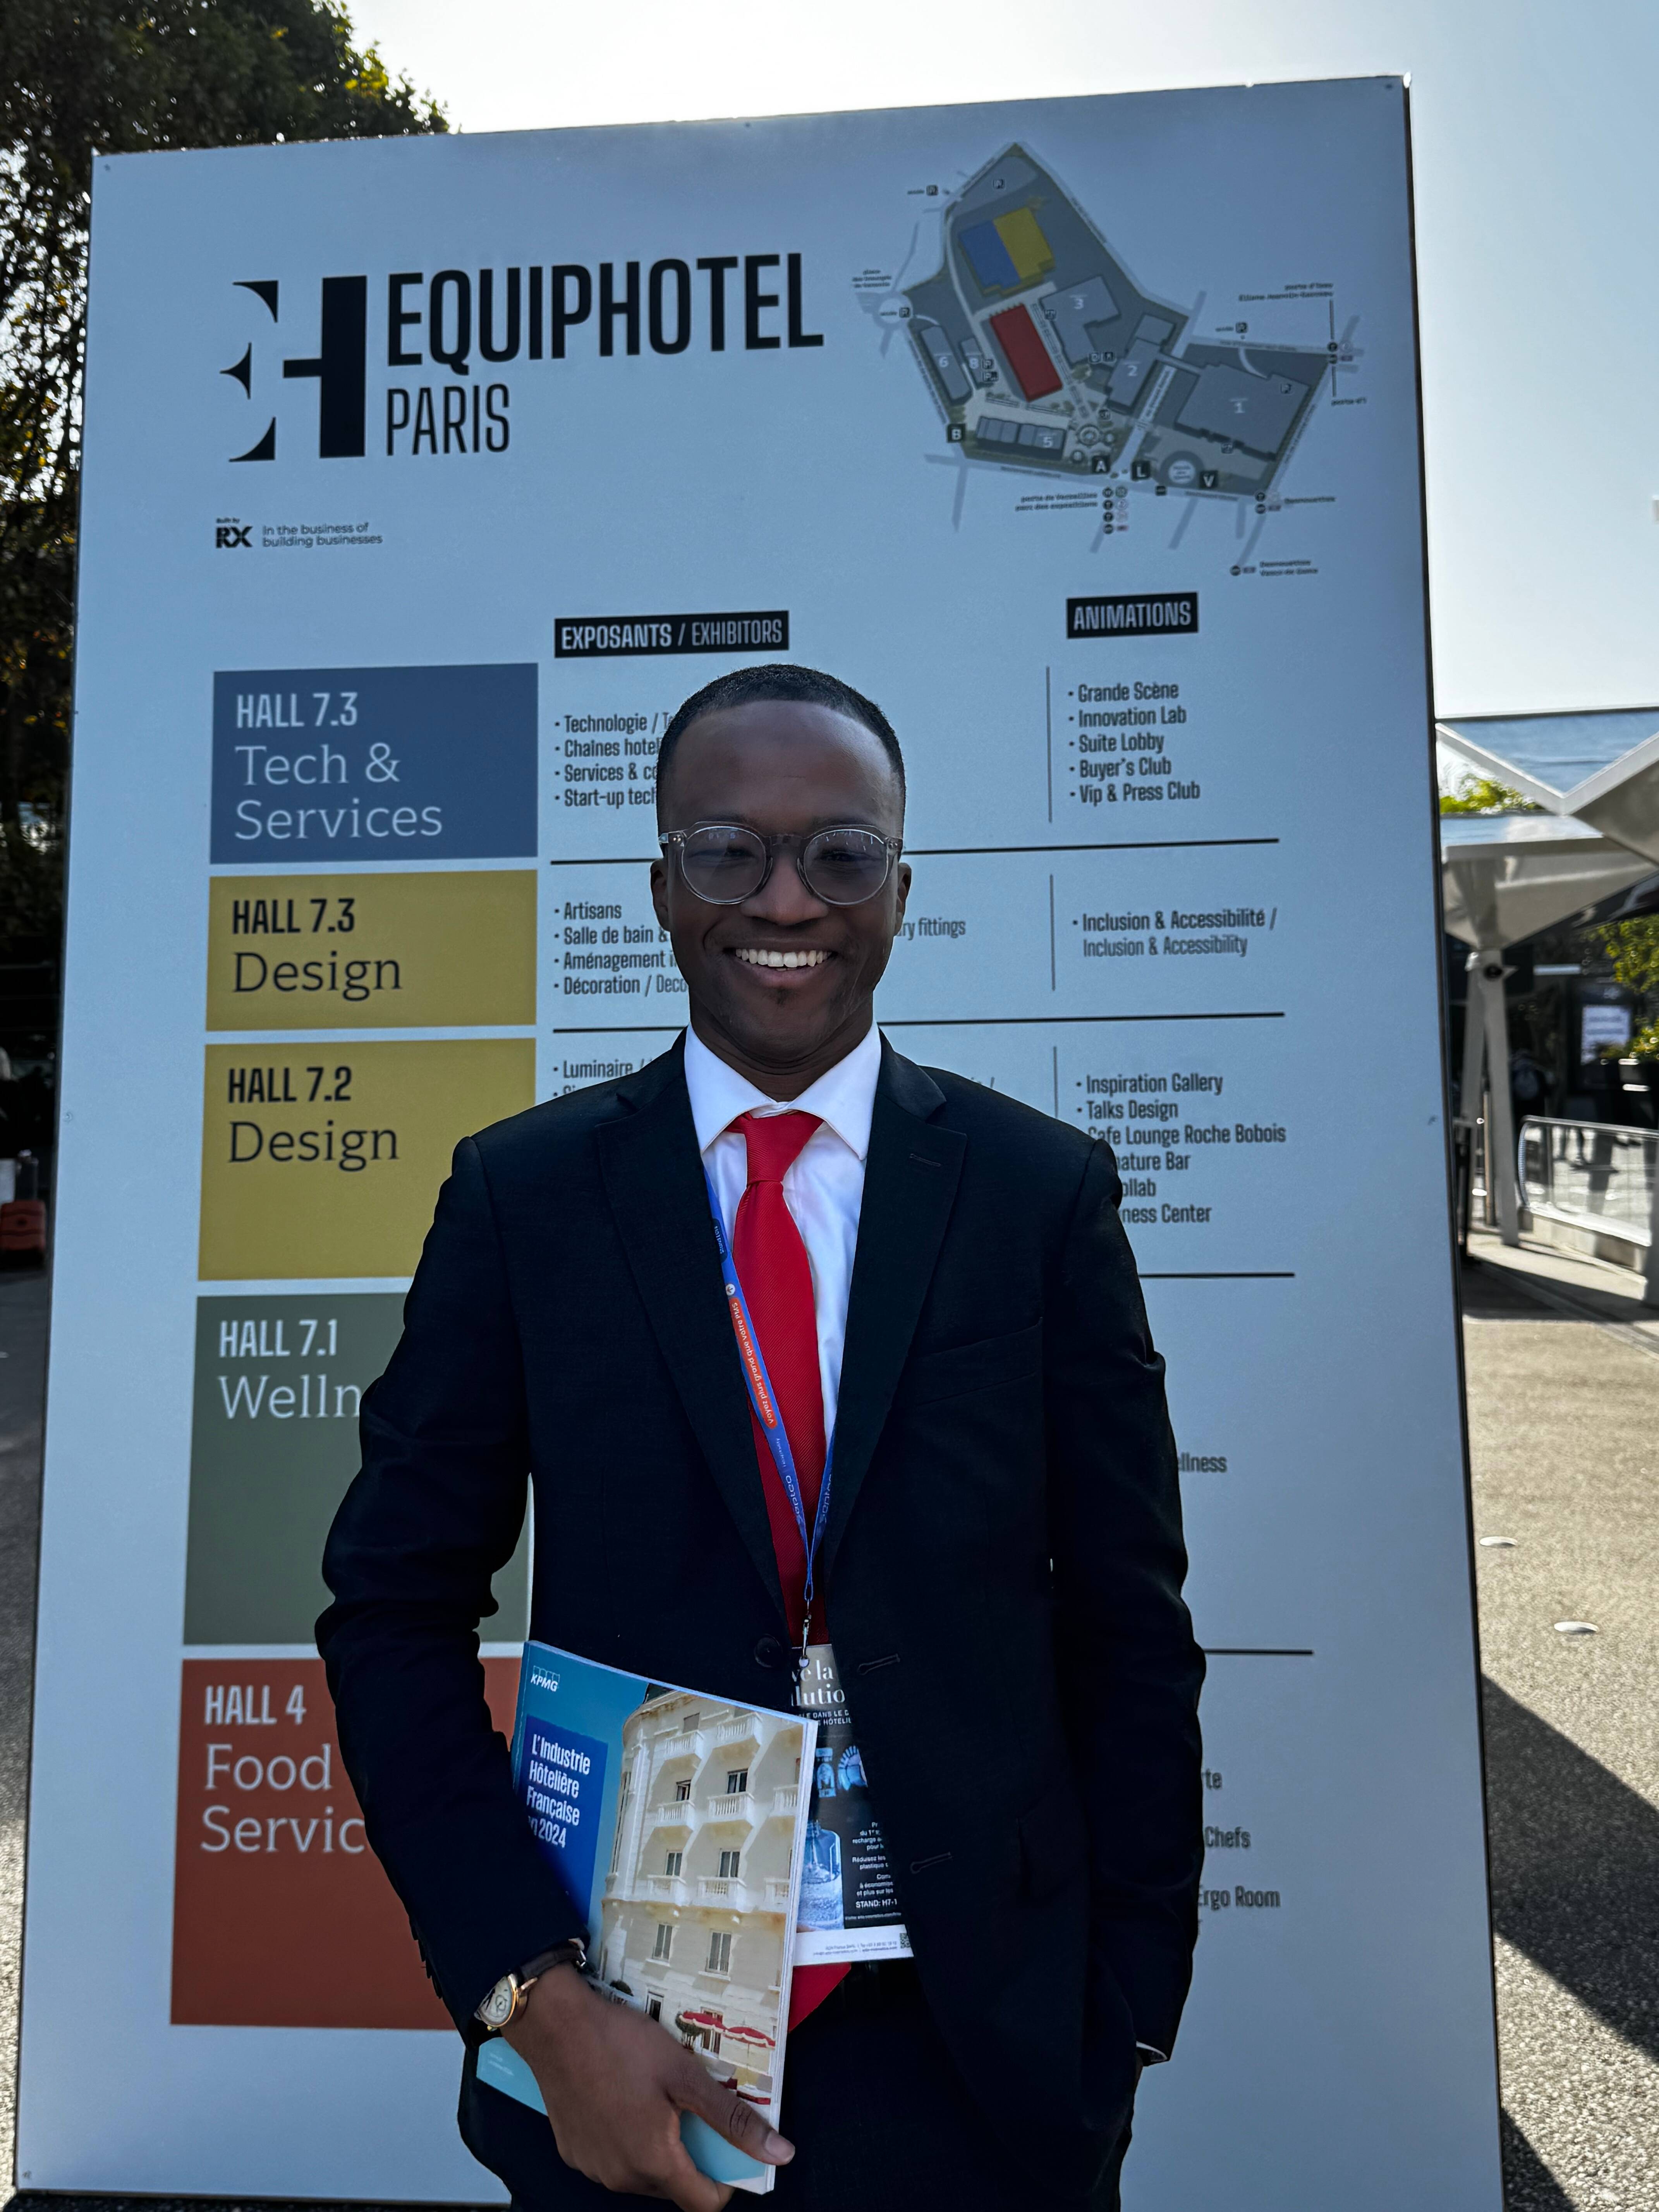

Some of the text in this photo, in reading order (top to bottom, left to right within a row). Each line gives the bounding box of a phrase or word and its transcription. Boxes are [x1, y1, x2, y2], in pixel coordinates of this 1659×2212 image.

[387, 252, 824, 376] EQUIPHOTEL
[1074, 298, 1084, 309] 3
[1127, 365, 1138, 376] 2
[1234, 401, 1246, 414] 1
[387, 383, 511, 456] PARIS
[951, 429, 961, 440] B
[1043, 437, 1053, 448] 5
[1096, 460, 1106, 472] A
[1137, 465, 1147, 477] L
[1203, 474, 1215, 487] V
[215, 526, 253, 549] RX
[277, 525, 298, 535] the
[301, 523, 354, 535] business
[356, 522, 369, 532] of
[263, 534, 383, 548] building businesses
[1073, 601, 1191, 630] ANIMATIONS
[562, 619, 782, 650] EXPOSANTS / EXHIBITORS
[1079, 682, 1179, 702] Grande Scène
[237, 692, 357, 728] HALL 7.3
[1079, 706, 1187, 728] Innovation Lab
[564, 713, 647, 734] Technologie
[652, 713, 658, 734] /
[625, 737, 659, 756] hotel
[1079, 732, 1164, 754] Suite Lobby
[235, 743, 401, 786] Tech &
[564, 763, 623, 782] Services
[628, 762, 638, 781] &
[1139, 757, 1171, 775] Club
[564, 788, 624, 809] Start-up
[1080, 781, 1200, 807] Vip & Press Club
[235, 797, 442, 840] Services
[234, 898, 355, 934] HALL 7.3
[564, 902, 622, 919] Artisans
[1083, 907, 1277, 931] Inclusion & Accessibilité /
[564, 926, 597, 945] Salle
[602, 926, 618, 944] de
[623, 925, 654, 943] bain
[919, 917, 966, 938] fittings
[1084, 934, 1248, 957] Inclusion & Accessibility
[564, 951, 666, 972] Aménagement
[234, 950, 402, 1002] Design
[564, 974, 688, 997] Décoration / Deco
[564, 1060, 633, 1078] Luminaire
[228, 1067, 352, 1103] HALL 7.2
[1087, 1073, 1223, 1097] Inspiration Gallery
[1087, 1099, 1178, 1121] Talks Design
[229, 1120, 400, 1172] Design
[1126, 1125, 1180, 1148] Lounge
[1185, 1125, 1230, 1143] Roche
[1236, 1124, 1286, 1143] Bobois
[1118, 1151, 1190, 1171] ature Bar
[1122, 1178, 1156, 1197] ollab
[1120, 1203, 1211, 1223] ness Center
[220, 1319, 337, 1357] HALL 7.1
[738, 1319, 747, 1340] votre
[744, 1340, 753, 1357] que
[748, 1357, 763, 1381] grand
[218, 1374, 362, 1419] Welln
[757, 1382, 768, 1399] plus
[1178, 1452, 1227, 1472] llness
[531, 1671, 559, 1692] KPMG
[792, 1660, 834, 1682] ve la
[205, 1685, 306, 1725] HALL 4
[796, 1683, 845, 1706] lutio
[205, 1743, 331, 1790] Food
[529, 1760, 579, 1799] Hôtelière
[1202, 1769, 1222, 1790] te
[526, 1786, 580, 1826] Française
[201, 1805, 365, 1853] Servic
[538, 1819, 567, 1849] 2024
[1205, 1826, 1251, 1849] Chefs
[856, 1900, 881, 1908] STAND:
[1235, 1885, 1280, 1907] Room
